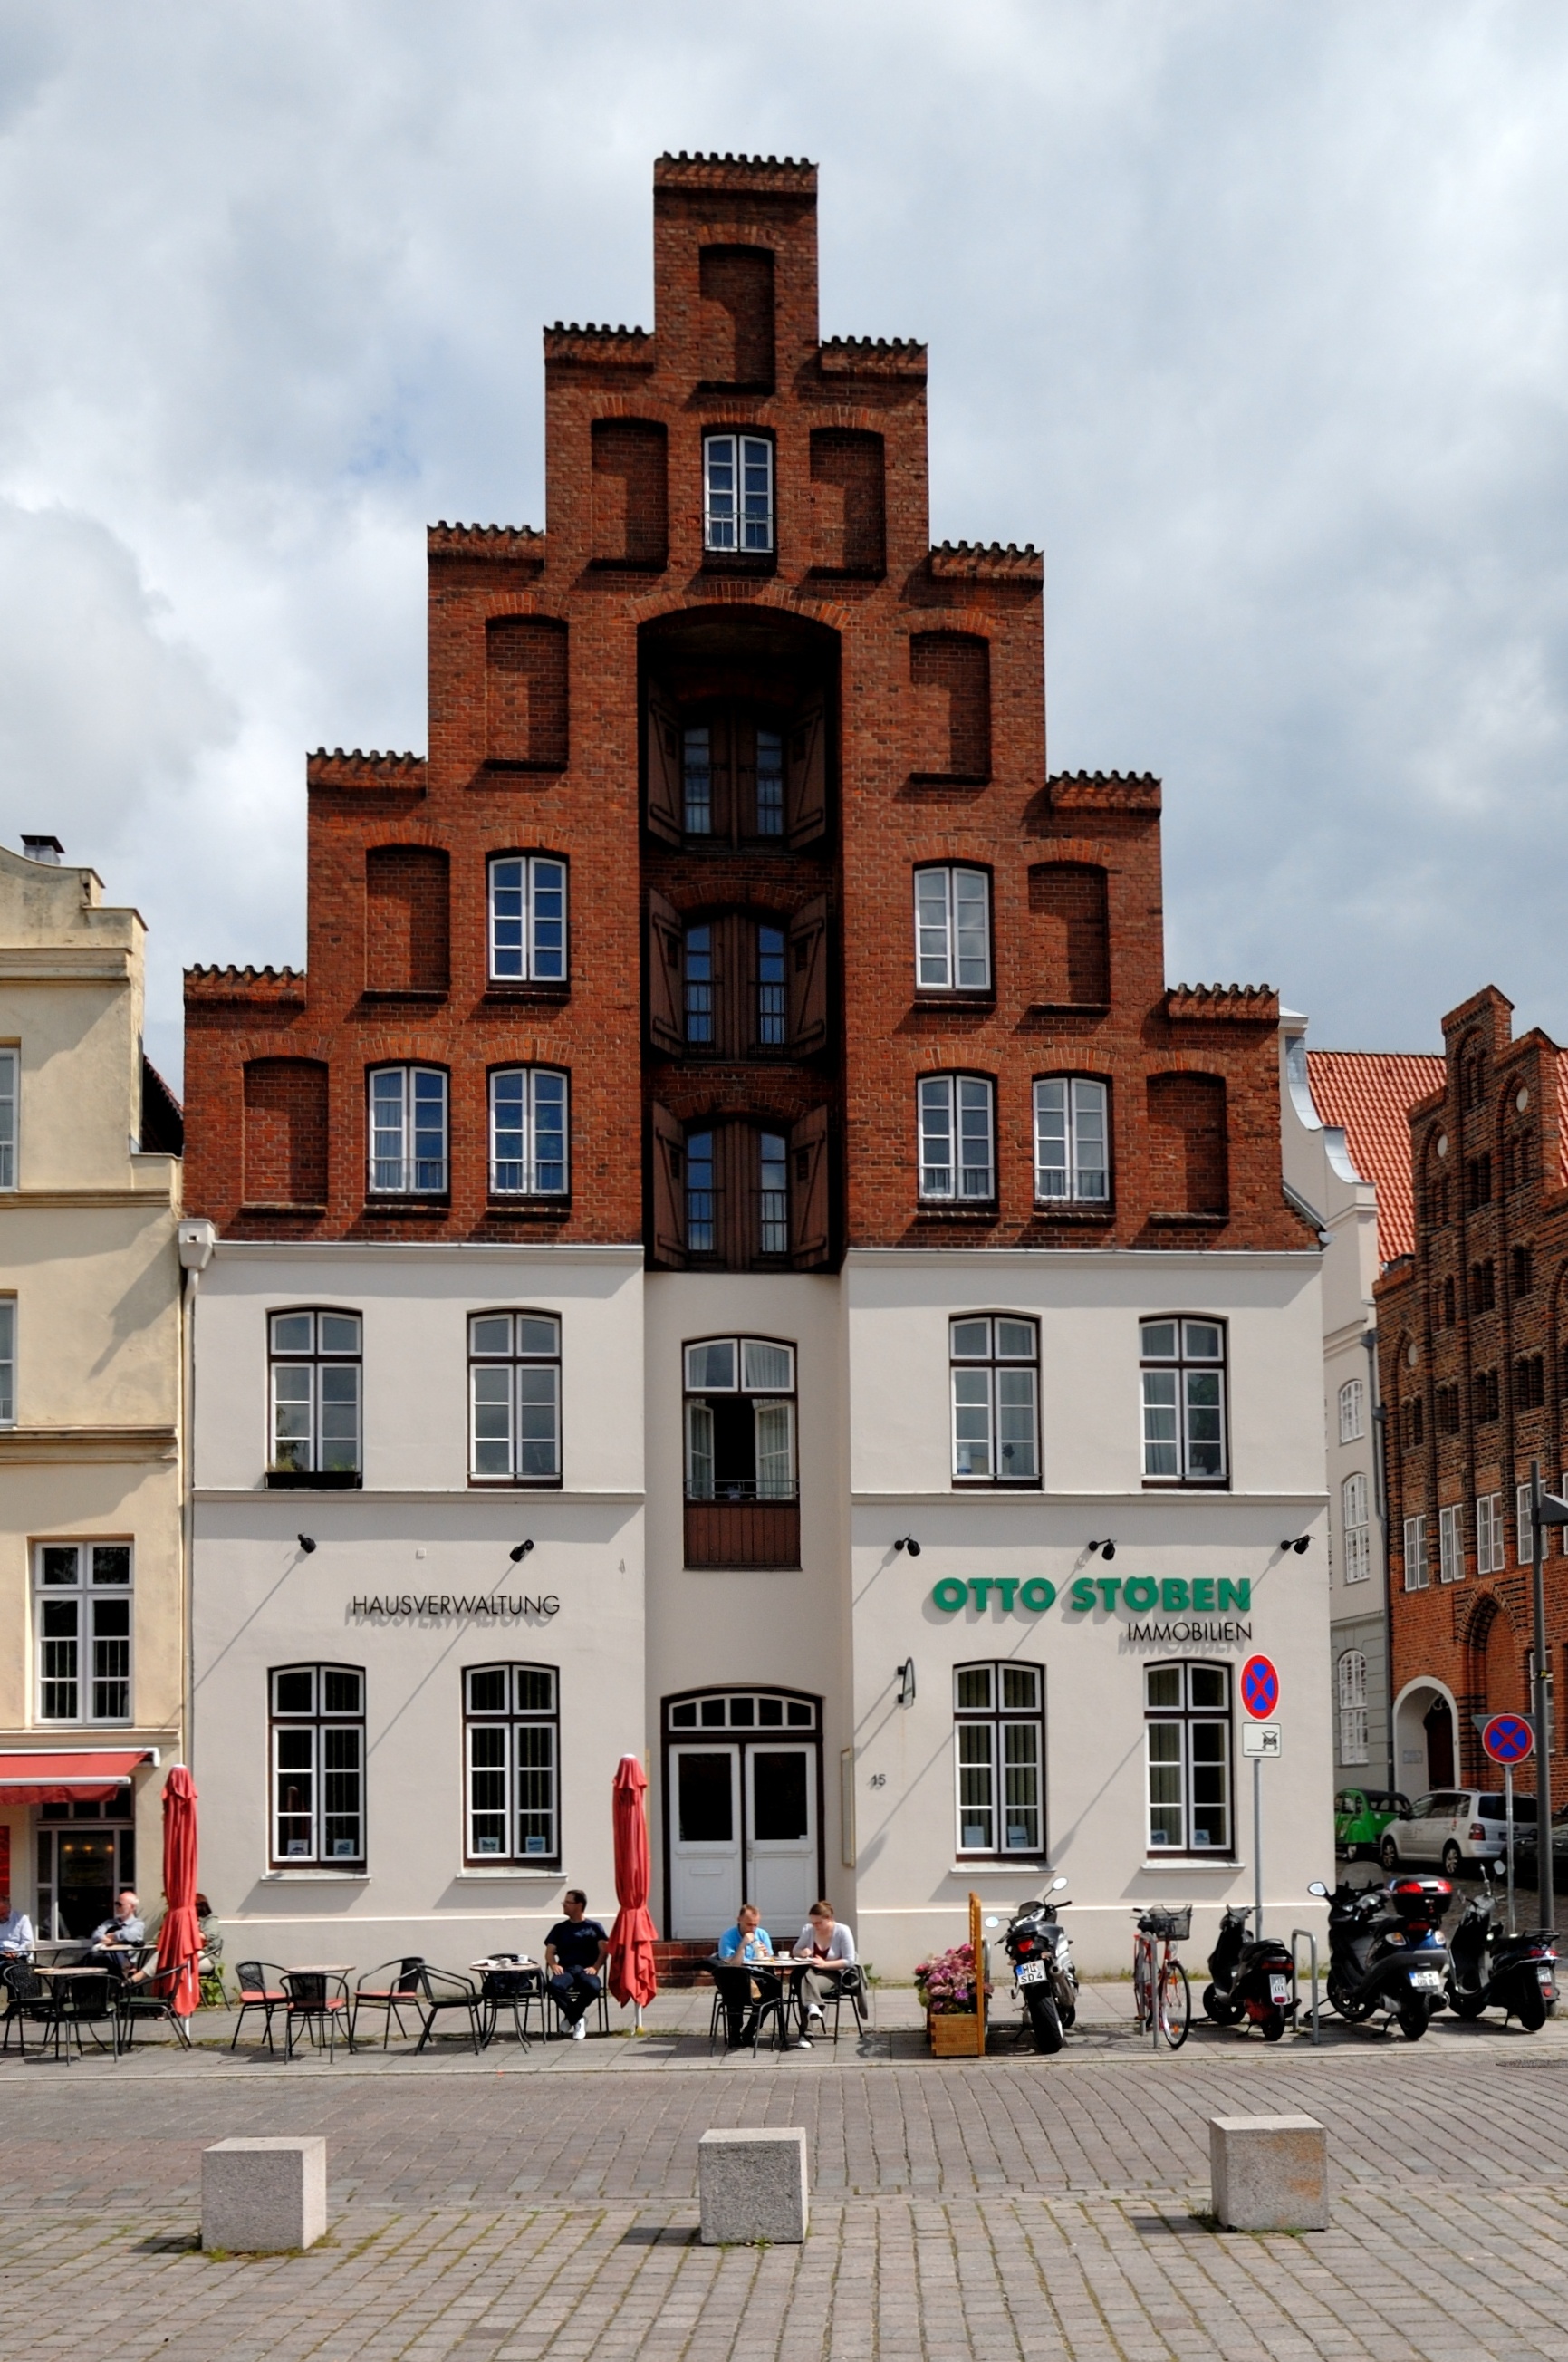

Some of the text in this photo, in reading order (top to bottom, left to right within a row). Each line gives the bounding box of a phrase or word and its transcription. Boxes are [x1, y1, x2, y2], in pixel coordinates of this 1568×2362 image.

[933, 1576, 1251, 1611] OTTO STÖBEN
[352, 1595, 560, 1615] HAUSVERWALTUNG
[1128, 1622, 1252, 1641] IMMOBILIEN
[871, 1773, 886, 1786] 15
